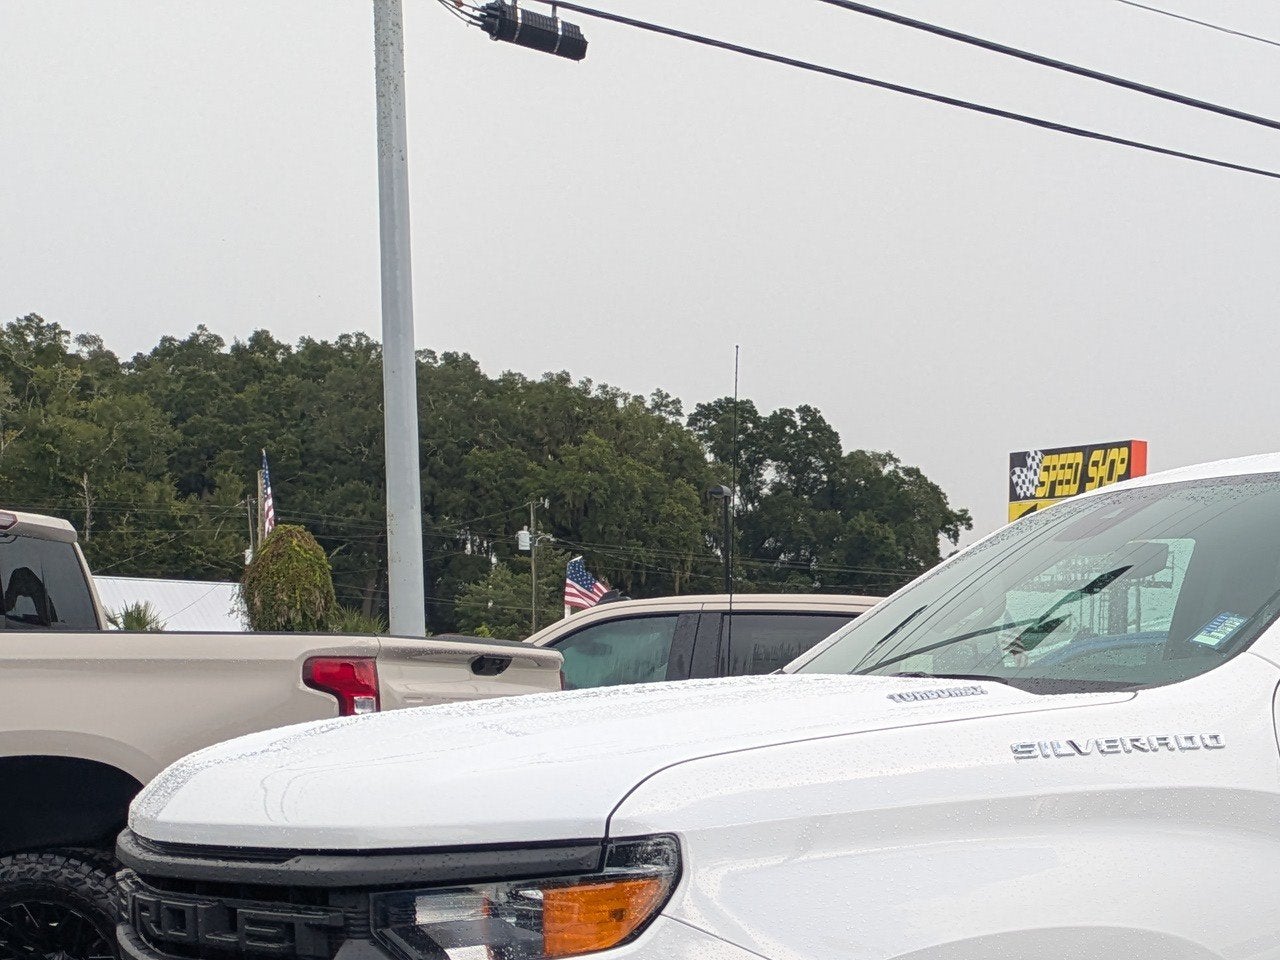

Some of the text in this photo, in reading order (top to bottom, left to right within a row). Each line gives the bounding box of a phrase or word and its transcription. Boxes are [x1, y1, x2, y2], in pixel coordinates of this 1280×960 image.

[1035, 446, 1129, 498] SPEED SHOP
[1009, 733, 1226, 761] SILVERADO
